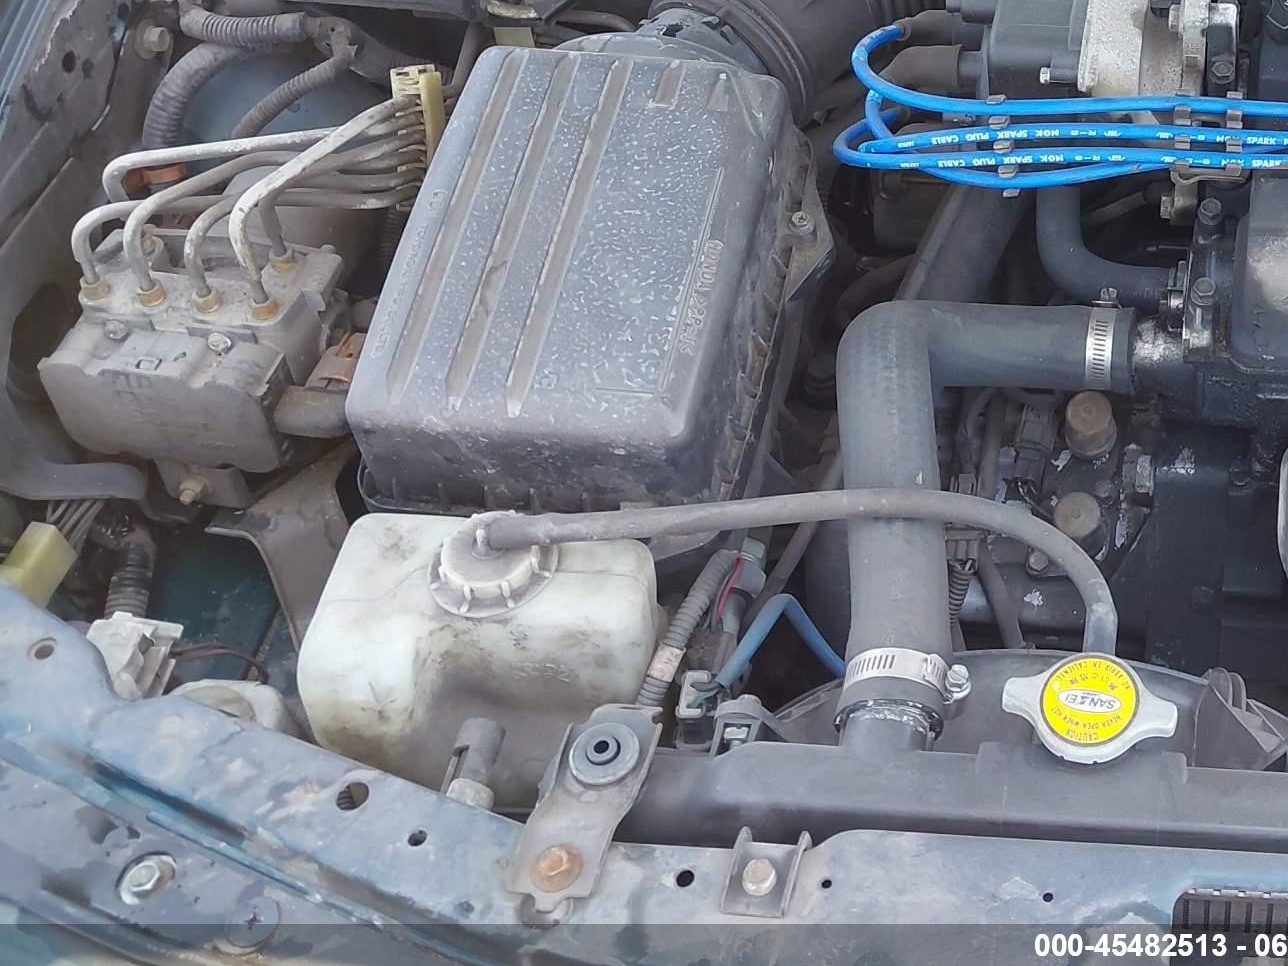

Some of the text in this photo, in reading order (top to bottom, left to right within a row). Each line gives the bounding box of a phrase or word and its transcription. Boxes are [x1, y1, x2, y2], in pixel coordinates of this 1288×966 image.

[963, 132, 990, 142] PLUG
[996, 129, 1028, 140] SPARK
[1035, 129, 1060, 138] NGK
[931, 134, 959, 145] CABLE
[1246, 136, 1277, 146] SPARK
[937, 158, 966, 168] CABLE
[972, 156, 996, 166] PLUG
[1002, 155, 1033, 166] SPARK
[1039, 154, 1064, 163] NGK
[1251, 158, 1282, 168] SPARK
[1104, 664, 1123, 679] ABRIR
[1063, 714, 1080, 726] WHEN
[1101, 714, 1121, 727] NEVER
[1065, 728, 1098, 741] CAUTION
